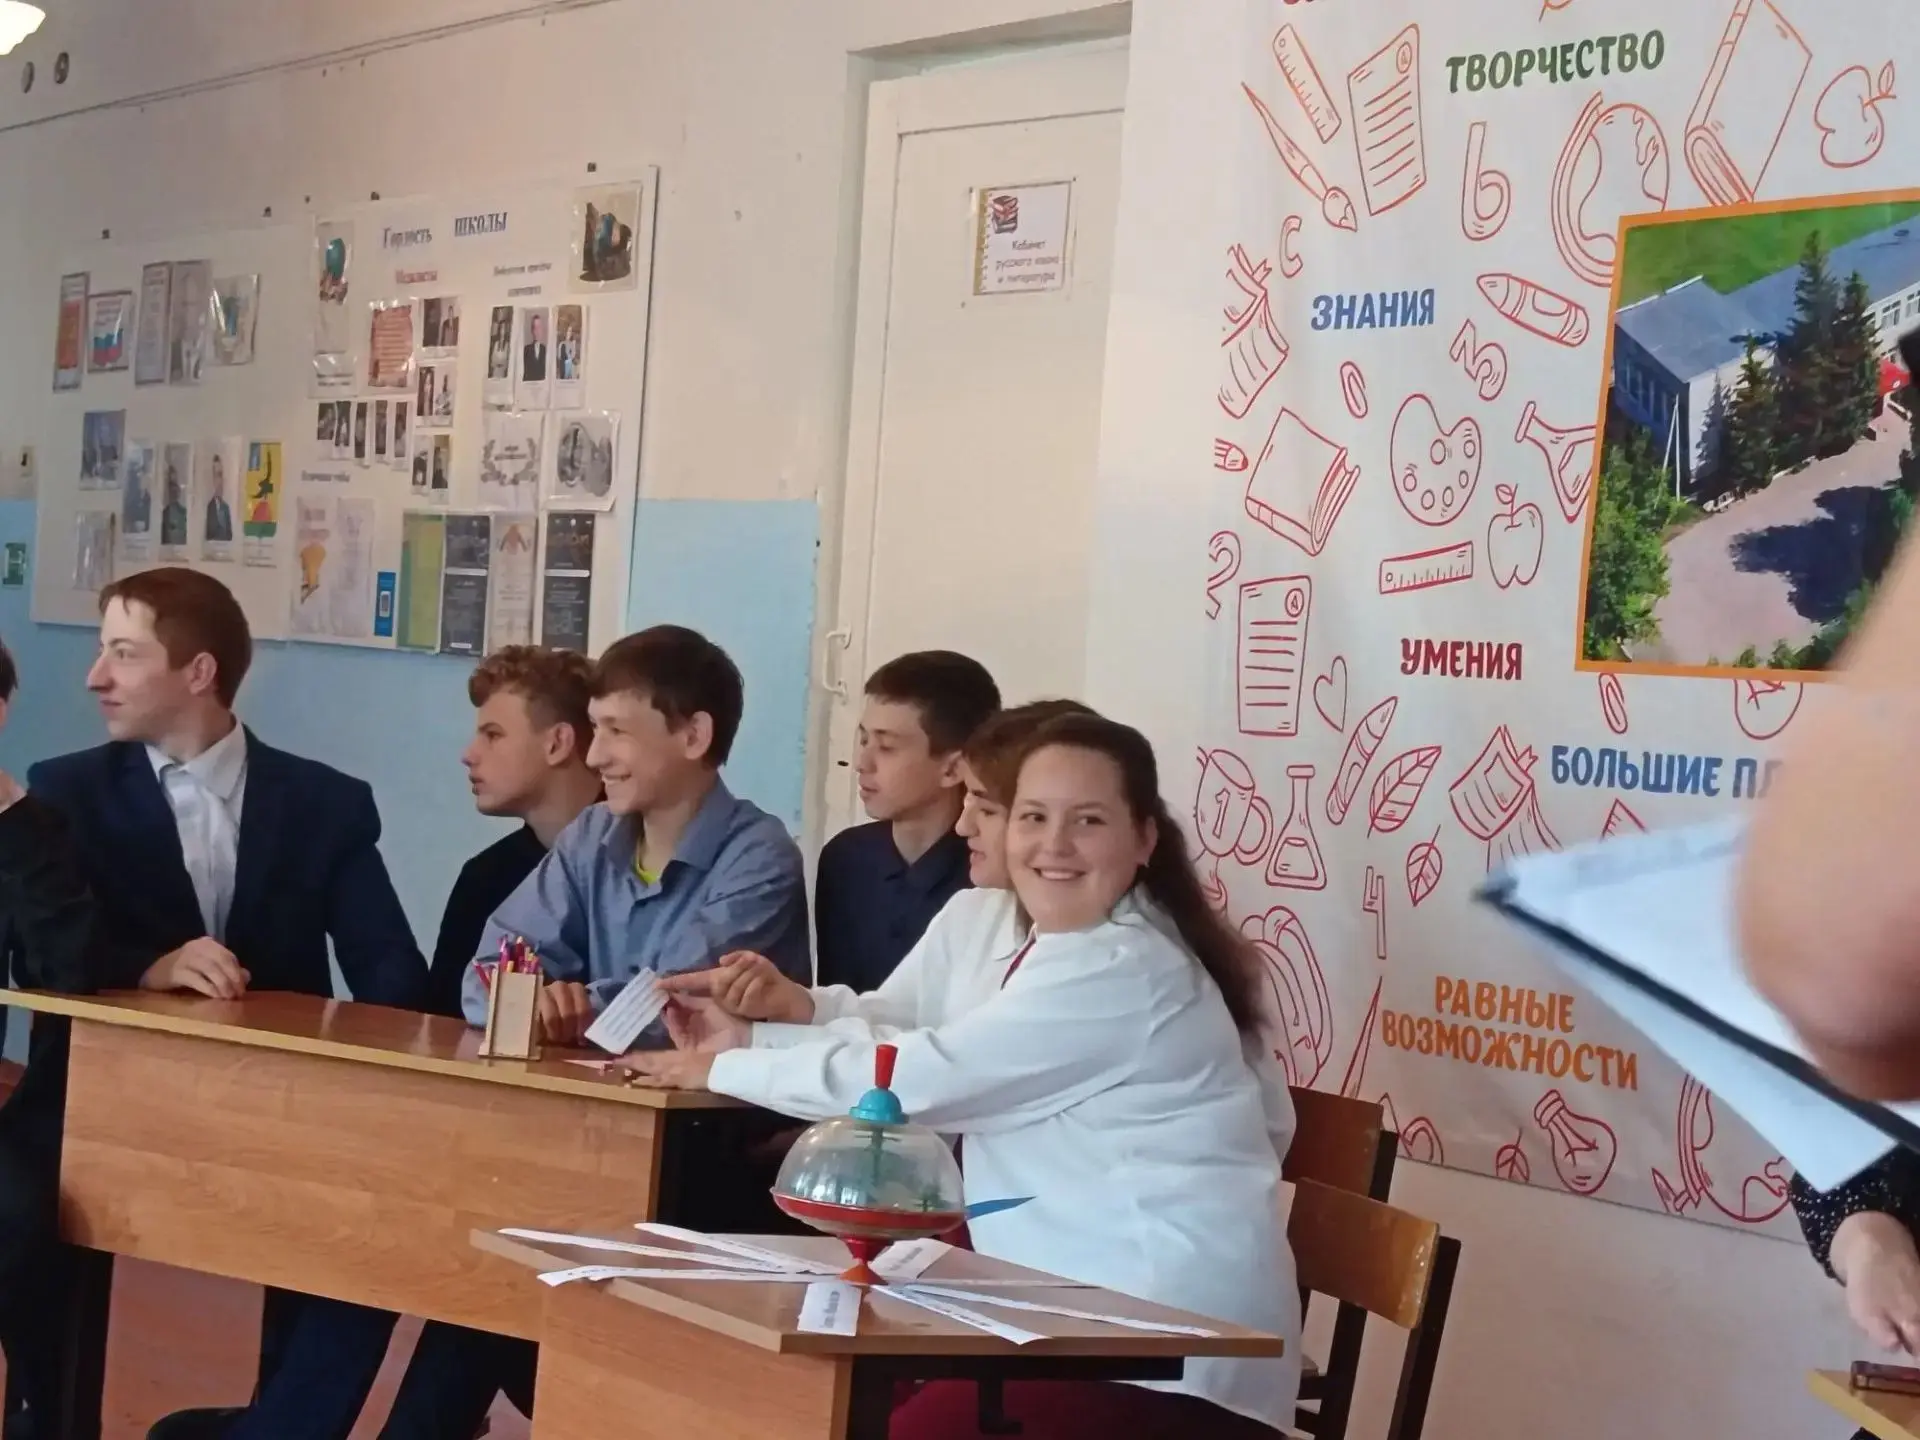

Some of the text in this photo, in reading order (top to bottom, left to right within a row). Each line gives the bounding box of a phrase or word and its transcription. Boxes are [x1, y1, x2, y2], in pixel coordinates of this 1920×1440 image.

[1445, 30, 1665, 94] ТВОРЧЕСТВО
[1311, 289, 1435, 330] ЗНАНИЯ
[1401, 638, 1522, 680] УМЕНИЯ
[1551, 745, 1723, 797] БОЛЬШИЕ
[1435, 976, 1575, 1033] РАВНЫЕ
[1382, 1010, 1638, 1091] ВОЗМОЖНОСТИ
